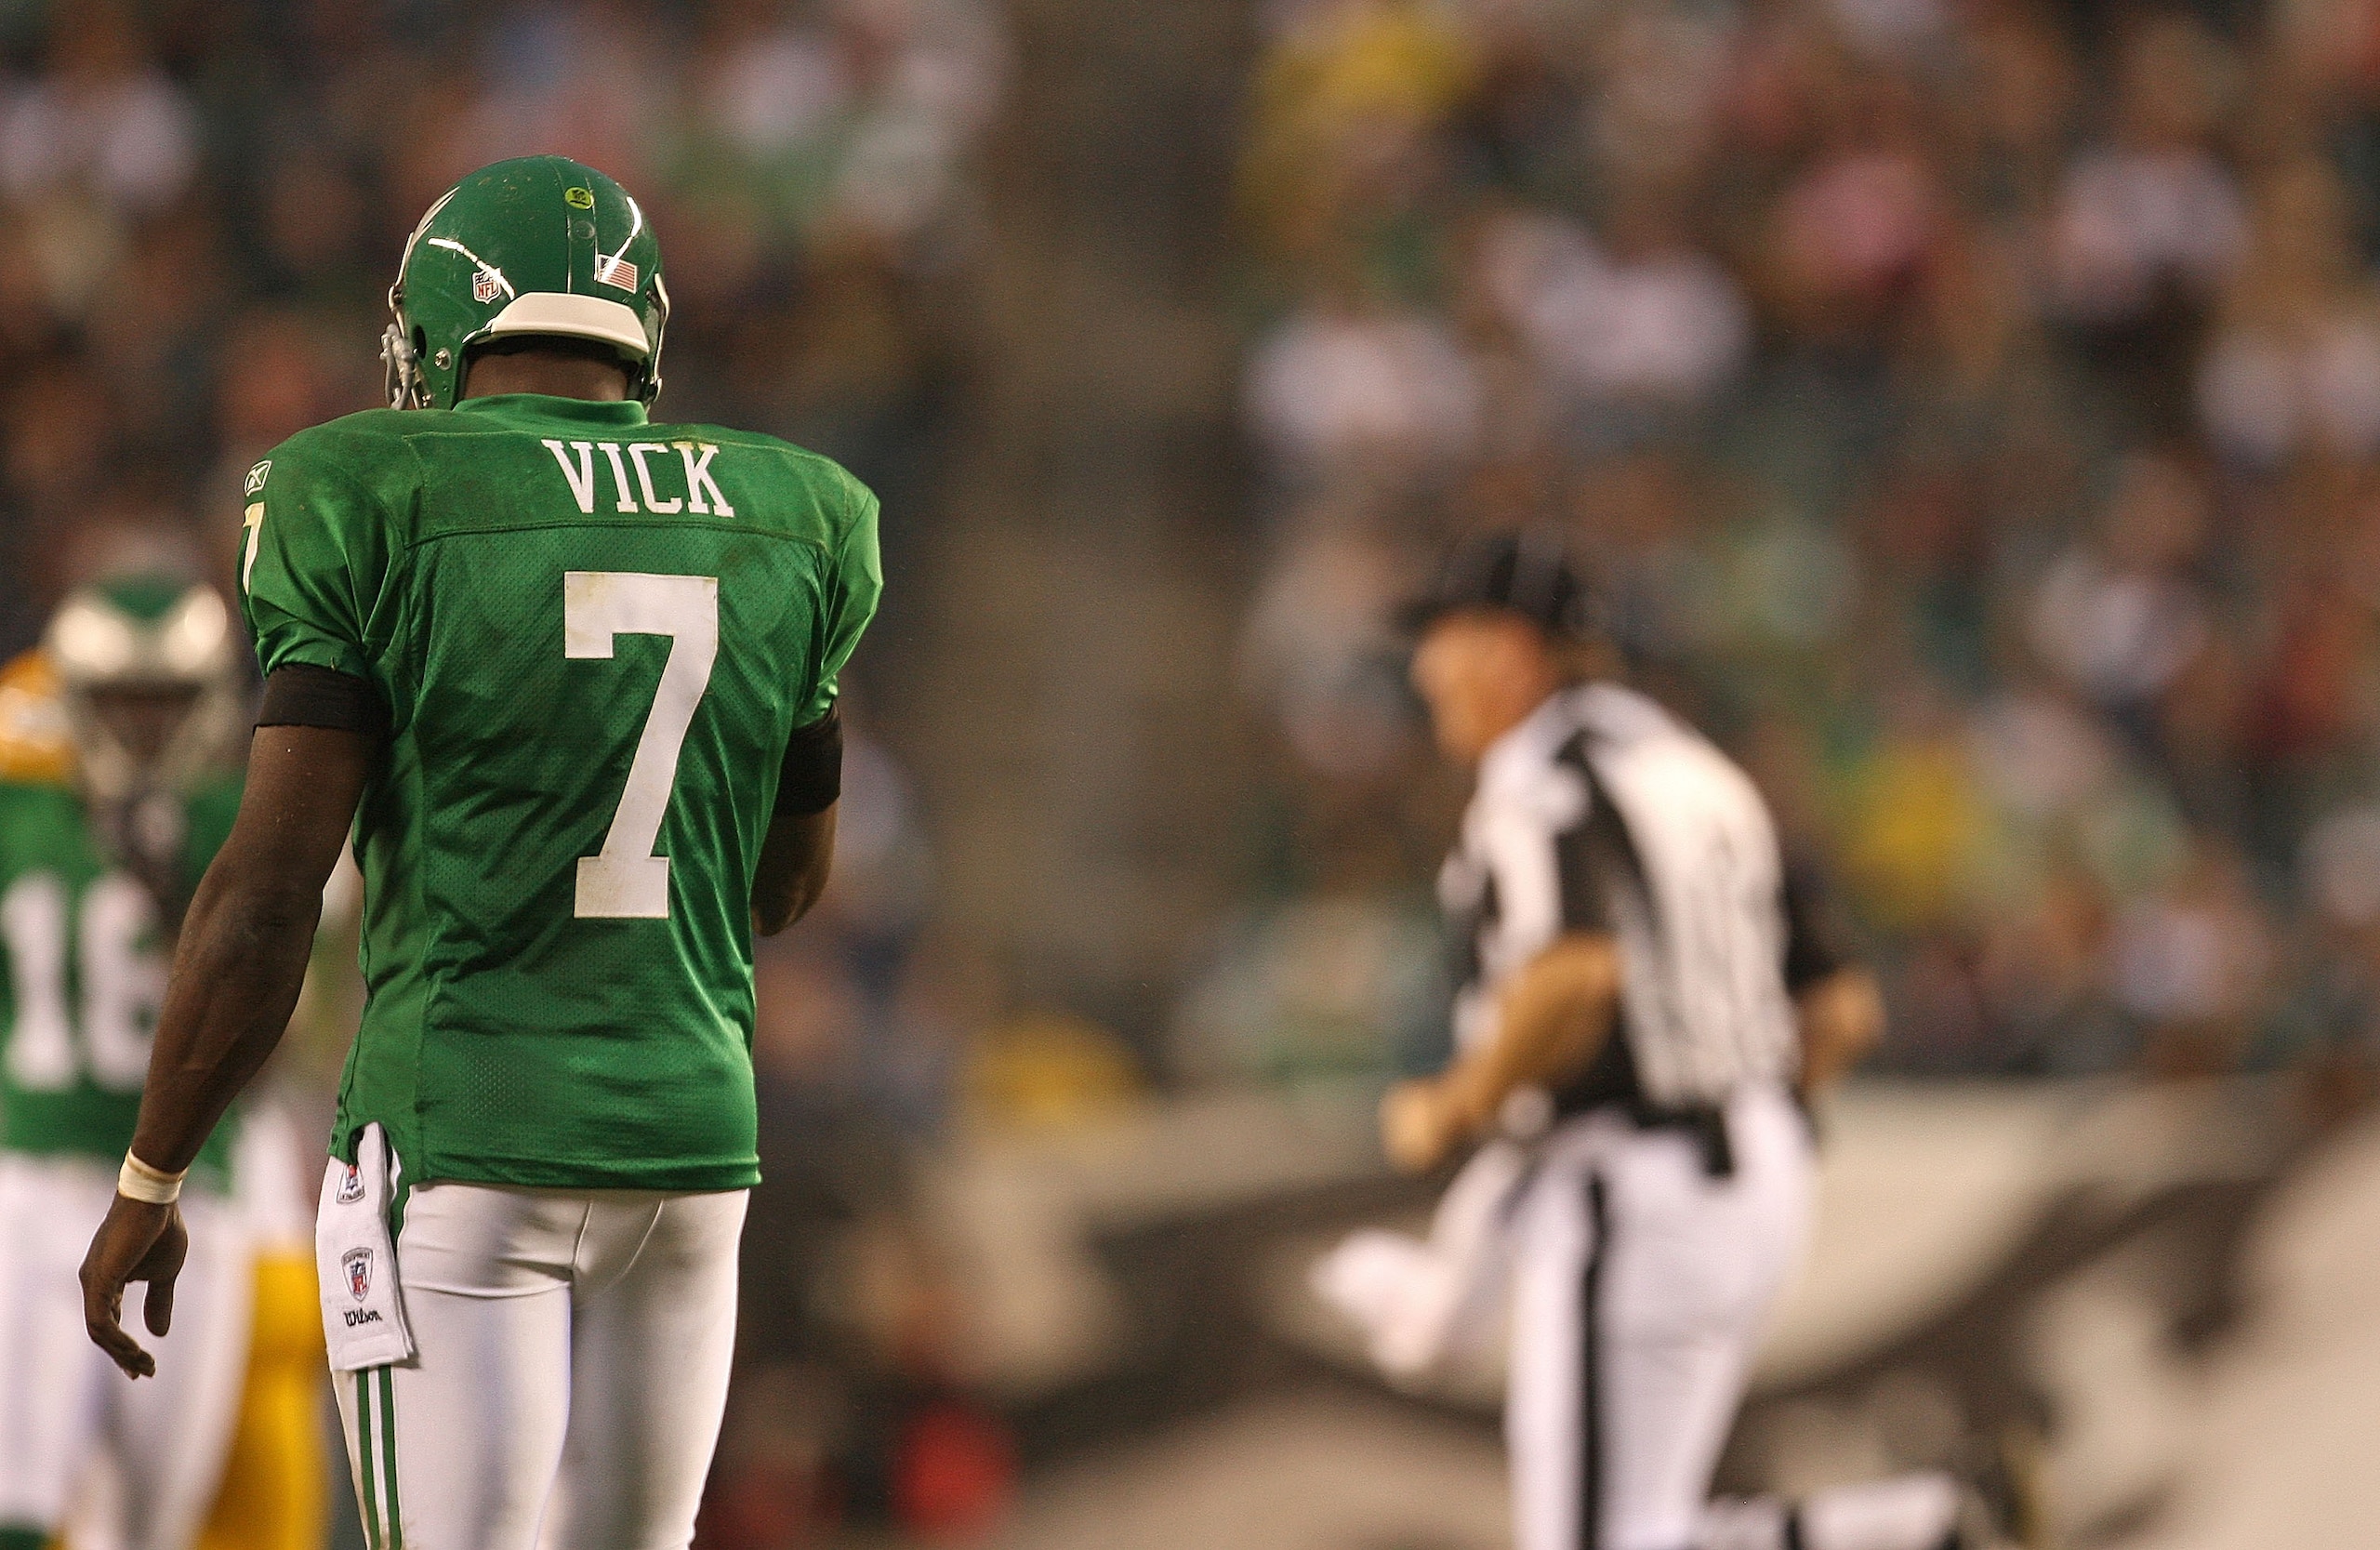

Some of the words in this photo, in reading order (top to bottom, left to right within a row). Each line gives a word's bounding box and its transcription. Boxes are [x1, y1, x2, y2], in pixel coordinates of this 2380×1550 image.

[477, 282, 498, 297] NFL
[541, 439, 734, 518] VICK
[564, 572, 718, 918] 7
[344, 1307, 382, 1327] Wilson
